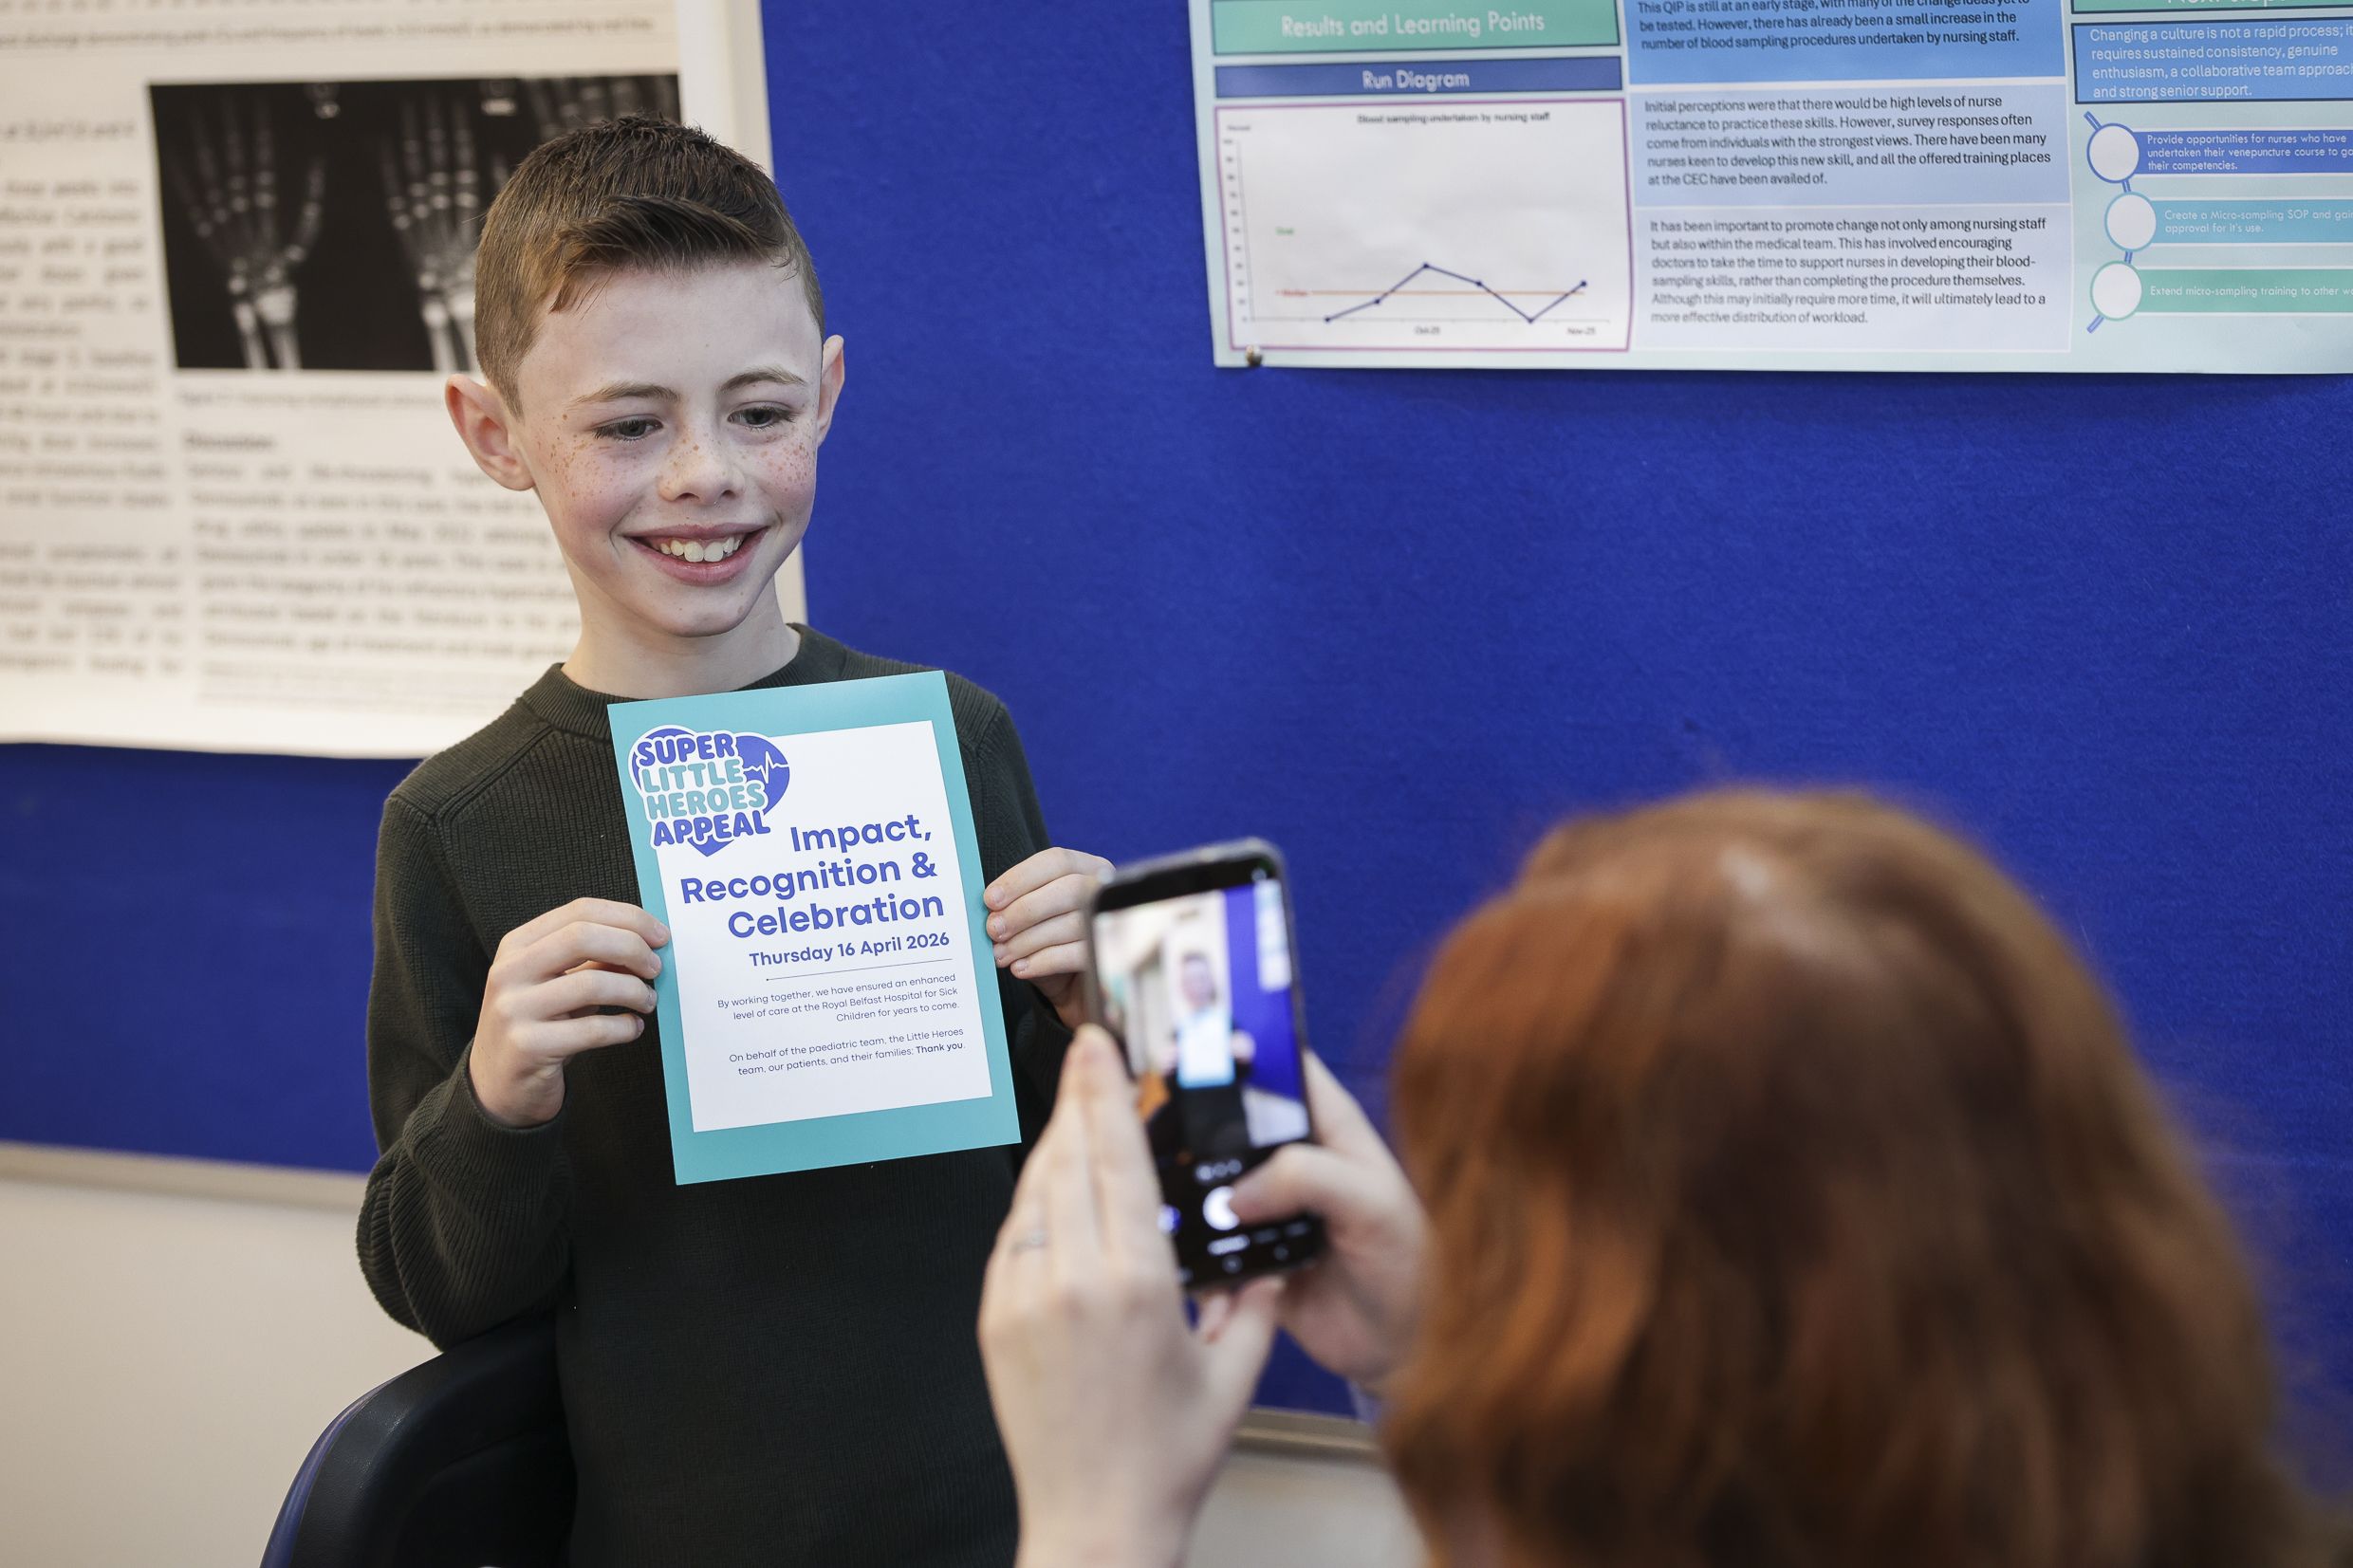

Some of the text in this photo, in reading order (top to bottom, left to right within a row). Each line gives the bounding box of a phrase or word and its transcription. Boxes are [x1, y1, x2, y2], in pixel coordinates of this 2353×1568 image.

[1282, 10, 1545, 38] Results and Learning Points
[1697, 11, 2016, 32] However, there has already been a small increase in the
[1734, 30, 2019, 50] sampling procedures undertaken by nursing staff.
[2090, 28, 2148, 44] Changing
[2150, 31, 2157, 40] a
[2160, 28, 2204, 40] culture
[2207, 28, 2216, 39] is
[2220, 28, 2240, 39] not
[2243, 29, 2250, 38] a
[2254, 27, 2286, 41] rapid
[2091, 47, 2141, 63] requires
[2143, 46, 2203, 59] sustained
[2288, 45, 2338, 60] genuine
[1362, 69, 1470, 92] Run Diagram
[2092, 66, 2168, 81] enthusiasm,
[2170, 69, 2177, 78] a
[2180, 65, 2260, 78] collaborative
[2263, 65, 2295, 76] team
[2094, 85, 2251, 101] and strong senior support.
[1872, 96, 2002, 111] be high levels of nurse
[1840, 114, 2031, 130] However, survey responses often
[1819, 134, 2046, 150] strongest views. There have been many
[2147, 135, 2183, 143] Provide
[2186, 134, 2248, 145] opportunities
[2251, 134, 2265, 143] for
[2300, 134, 2320, 142] who
[2323, 134, 2345, 142] have
[1827, 152, 2050, 167] skill, and all the offered training places
[2147, 148, 2200, 157] undertaken
[2204, 148, 2224, 157] their
[2228, 148, 2290, 159] venepuncture
[2328, 148, 2338, 157] to
[2148, 160, 2237, 172] their competencies.
[1902, 218, 2046, 232] only among nursing staff
[1888, 237, 2011, 251] involved encouraging
[1966, 256, 2035, 267] their blood-
[1953, 274, 2025, 286] themselves.
[638, 733, 735, 766] SUPER
[642, 759, 744, 793] LITTLE
[647, 784, 765, 820] HEROES
[654, 810, 770, 846] APPEAL
[790, 815, 931, 853] Impact,
[680, 852, 937, 904] Recognition &
[728, 894, 944, 938] Celebration
[749, 932, 950, 967] Thursday 16 April 2026
[717, 999, 730, 1010] By
[731, 994, 769, 1008] working
[770, 989, 813, 1005] together,
[830, 985, 853, 995] have
[855, 980, 893, 992] ensured
[909, 973, 955, 987] enhanced
[733, 987, 957, 1020] level of care at the Royal Belfast Hospital for Sick
[836, 1009, 876, 1022] Children
[878, 1007, 891, 1018] for
[893, 1006, 917, 1018] years
[919, 1004, 929, 1013] to
[729, 1052, 743, 1062] On
[746, 1049, 776, 1061] behalf
[778, 1047, 788, 1057] of
[790, 1045, 806, 1056] the
[808, 1040, 858, 1056] paediatric
[888, 1034, 904, 1044] the
[906, 1031, 930, 1042] Little
[932, 1027, 963, 1040] Heroes
[768, 1063, 784, 1072] our
[829, 1054, 848, 1064] and
[851, 1051, 873, 1062] their
[915, 1042, 944, 1055] Thank
